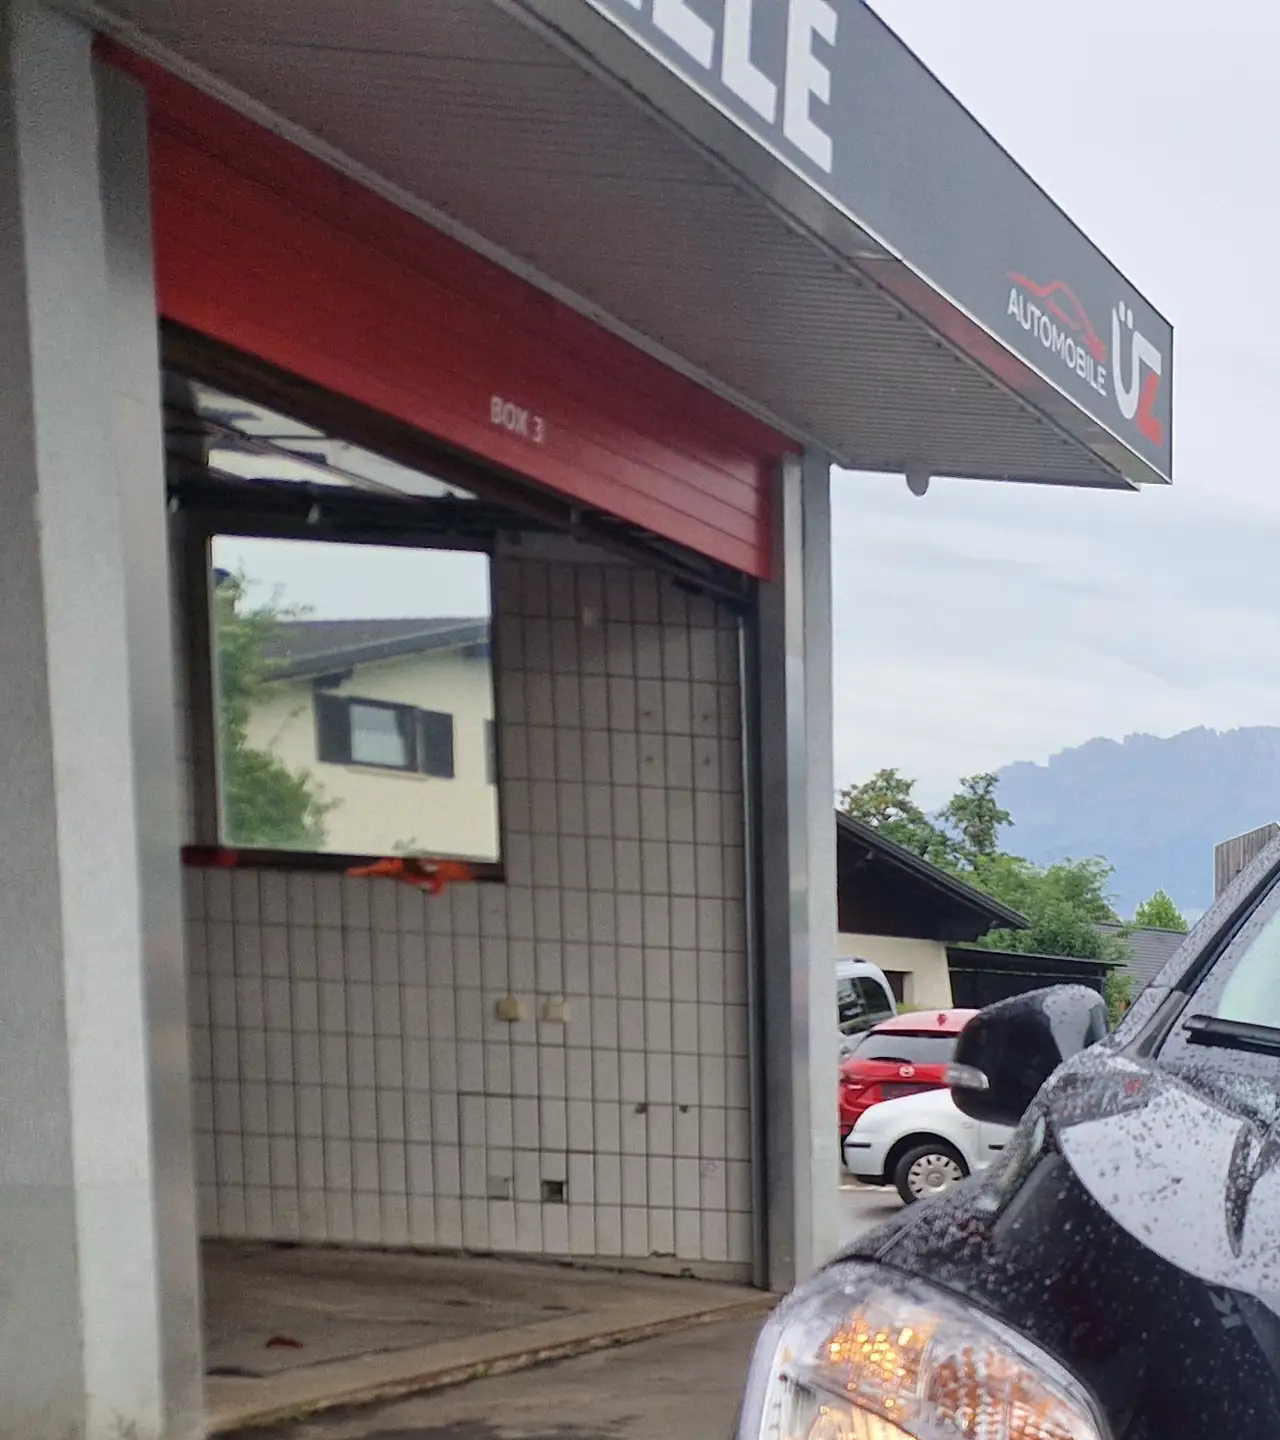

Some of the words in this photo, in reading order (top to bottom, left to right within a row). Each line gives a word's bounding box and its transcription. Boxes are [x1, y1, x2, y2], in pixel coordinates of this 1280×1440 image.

[490, 394, 529, 437] BOX
[531, 414, 545, 443] 3
[1007, 287, 1108, 397] AUTOMOBILE
[1111, 300, 1164, 448] ÜZ
